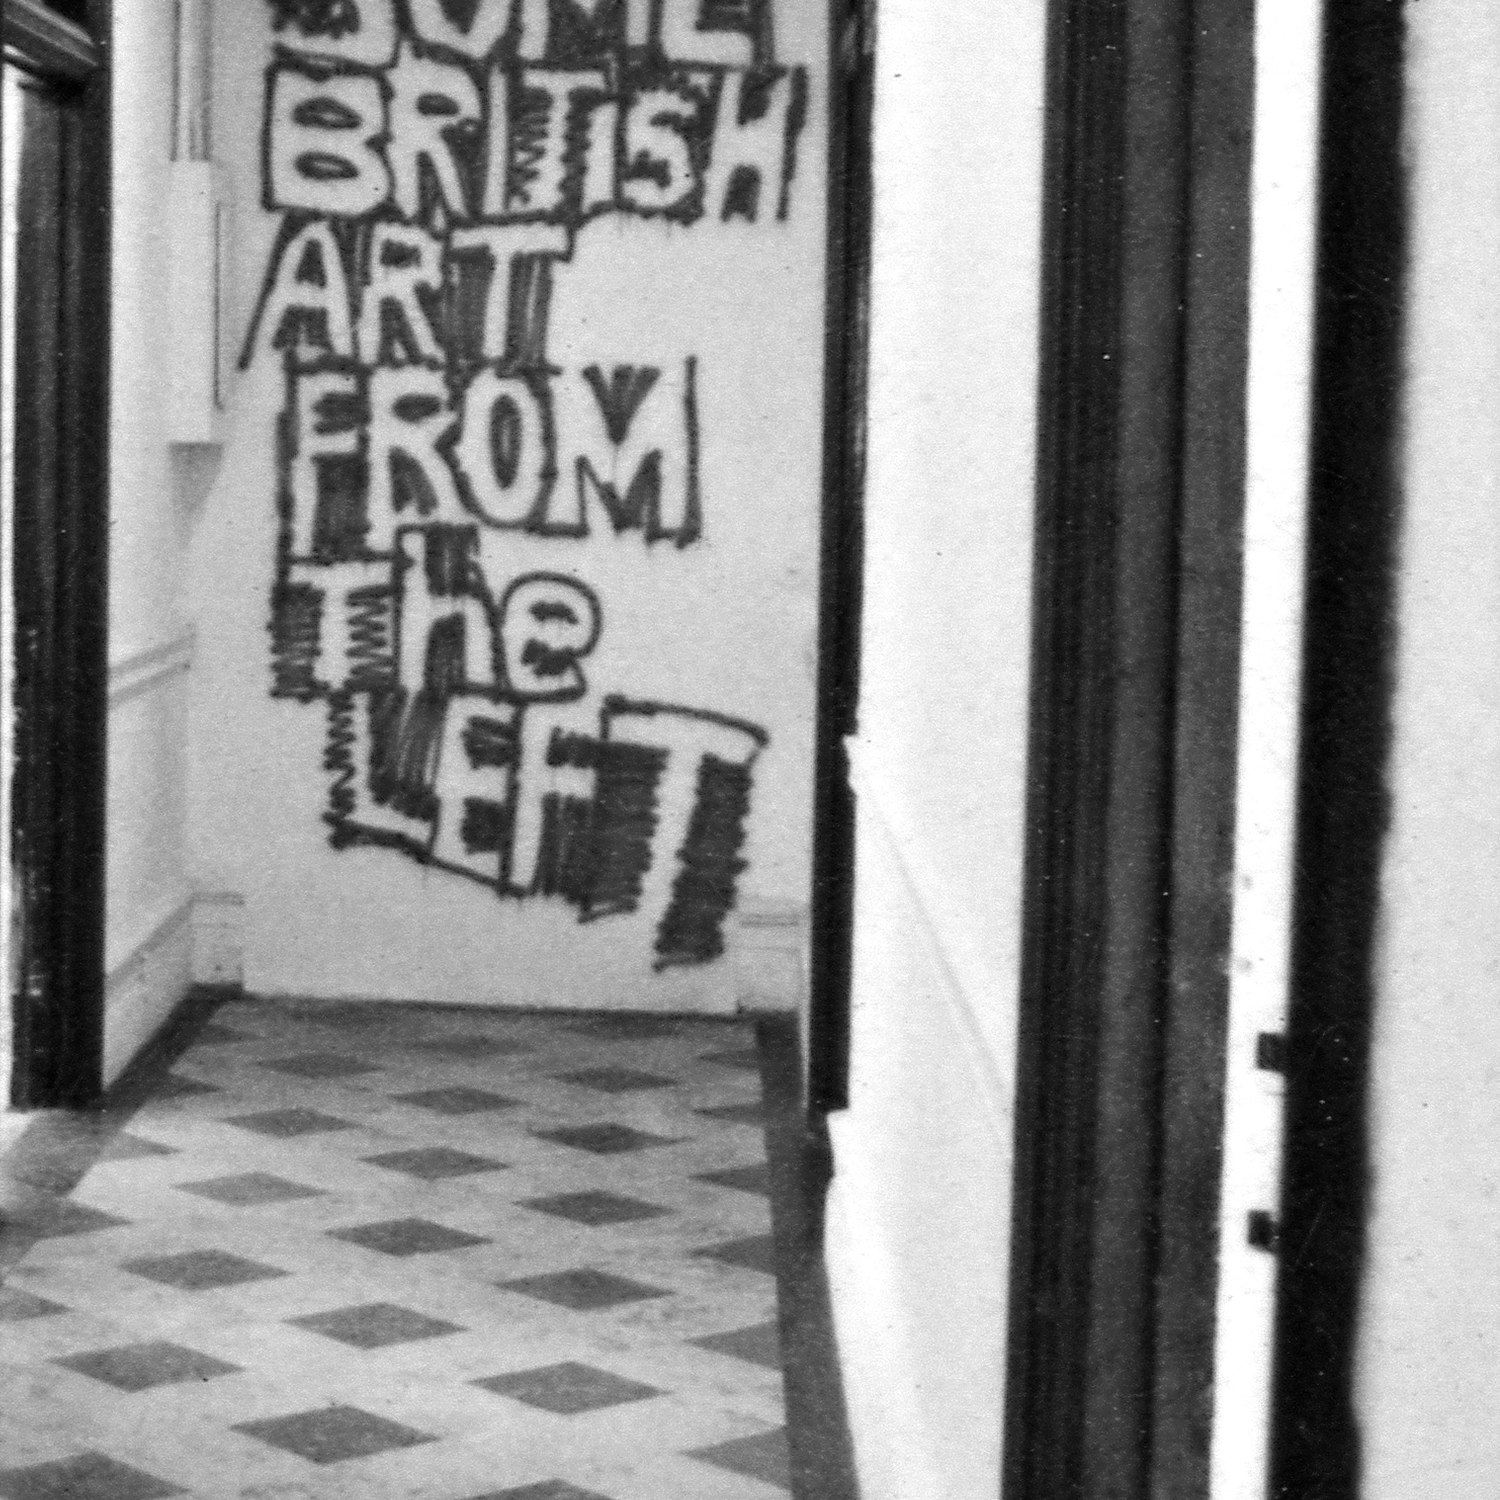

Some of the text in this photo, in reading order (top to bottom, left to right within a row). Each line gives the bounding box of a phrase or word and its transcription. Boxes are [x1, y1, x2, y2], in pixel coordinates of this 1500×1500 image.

[262, 60, 808, 222] BRITISH
[238, 212, 572, 372] ART
[276, 355, 700, 564] FROM
[322, 695, 768, 971] LEFT
